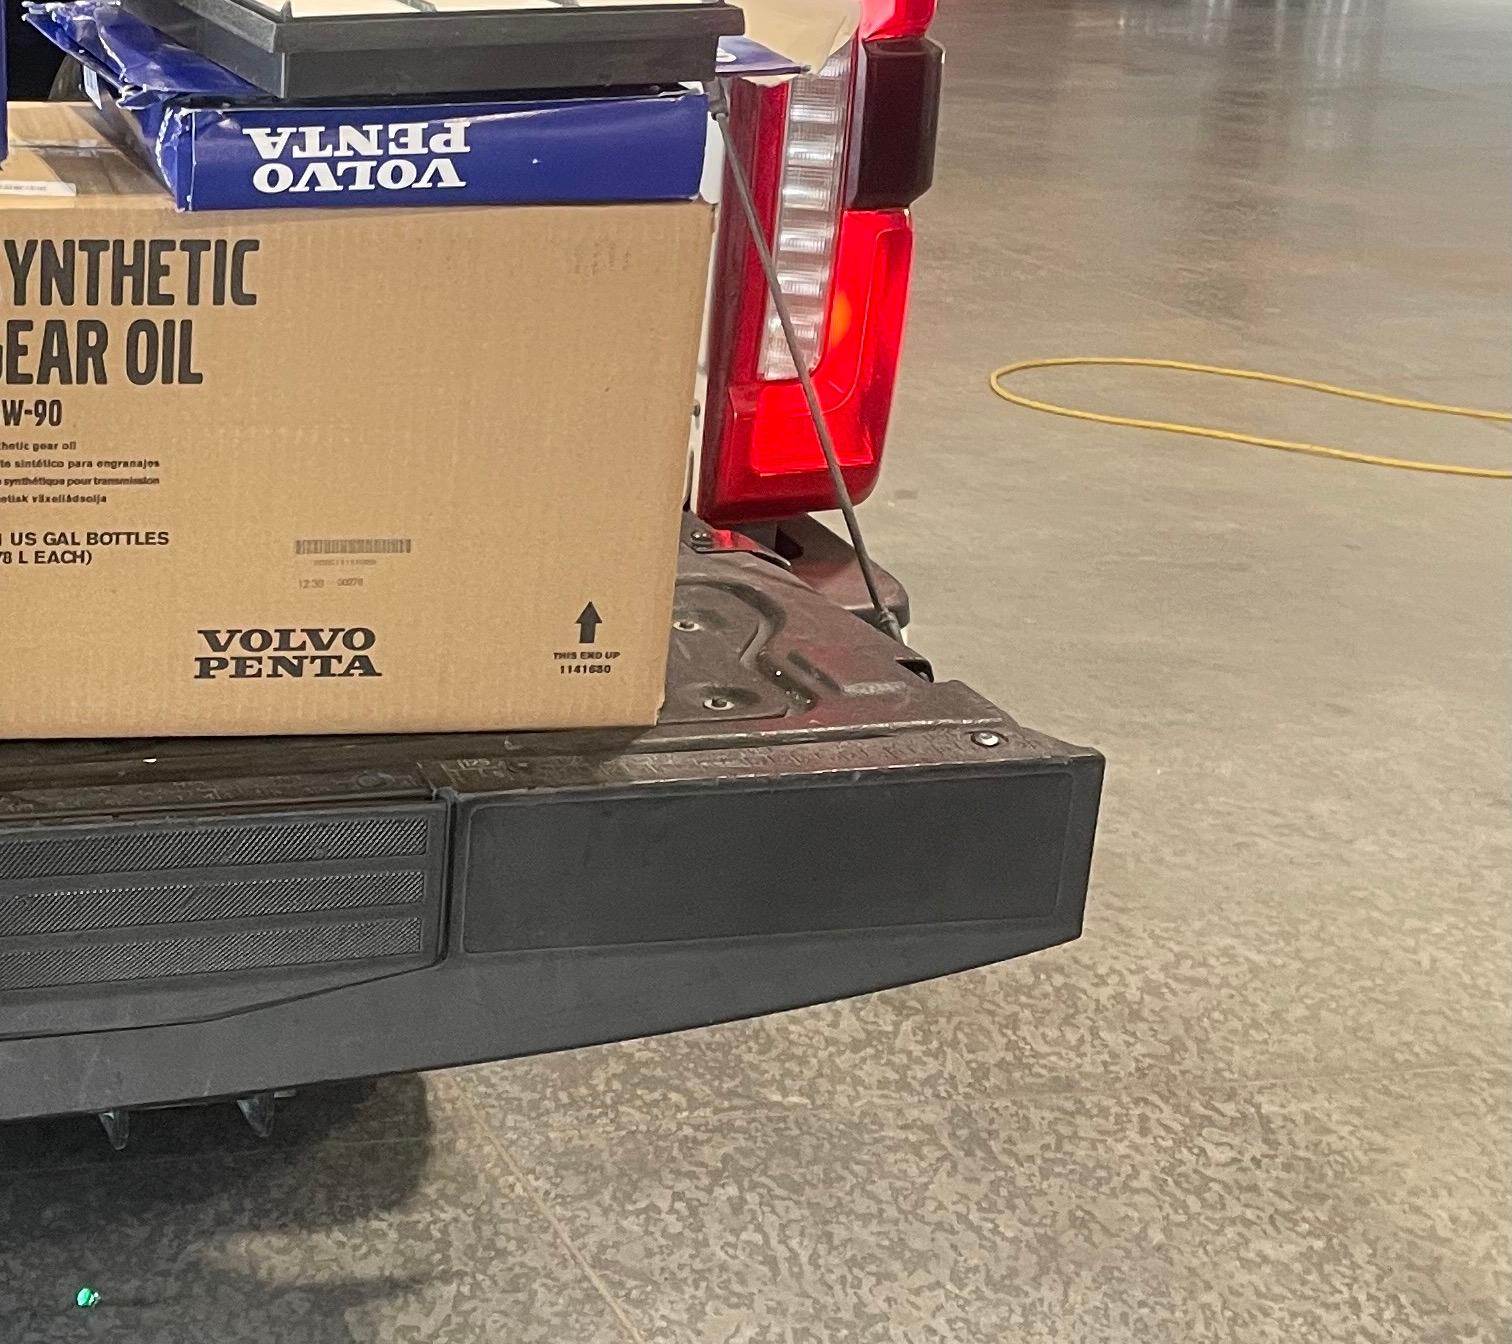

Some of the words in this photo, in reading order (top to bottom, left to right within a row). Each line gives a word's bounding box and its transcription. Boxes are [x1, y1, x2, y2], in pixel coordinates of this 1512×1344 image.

[242, 122, 471, 160] PENTA
[252, 158, 467, 194] VOLVO
[125, 318, 203, 386] OIL
[32, 442, 58, 453] gear
[61, 441, 77, 450] oil
[67, 460, 93, 470] para
[96, 459, 160, 470] engranajes
[66, 477, 92, 487] pour
[10, 532, 37, 546] US
[43, 532, 81, 546] GAL
[86, 531, 170, 546] BOTTLES
[18, 551, 29, 565] L
[34, 550, 93, 566] EACH)
[197, 627, 376, 653] VOLVO
[553, 651, 577, 660] THIS
[580, 651, 603, 660] END
[604, 651, 621, 660] UP
[194, 655, 382, 679] PENTA
